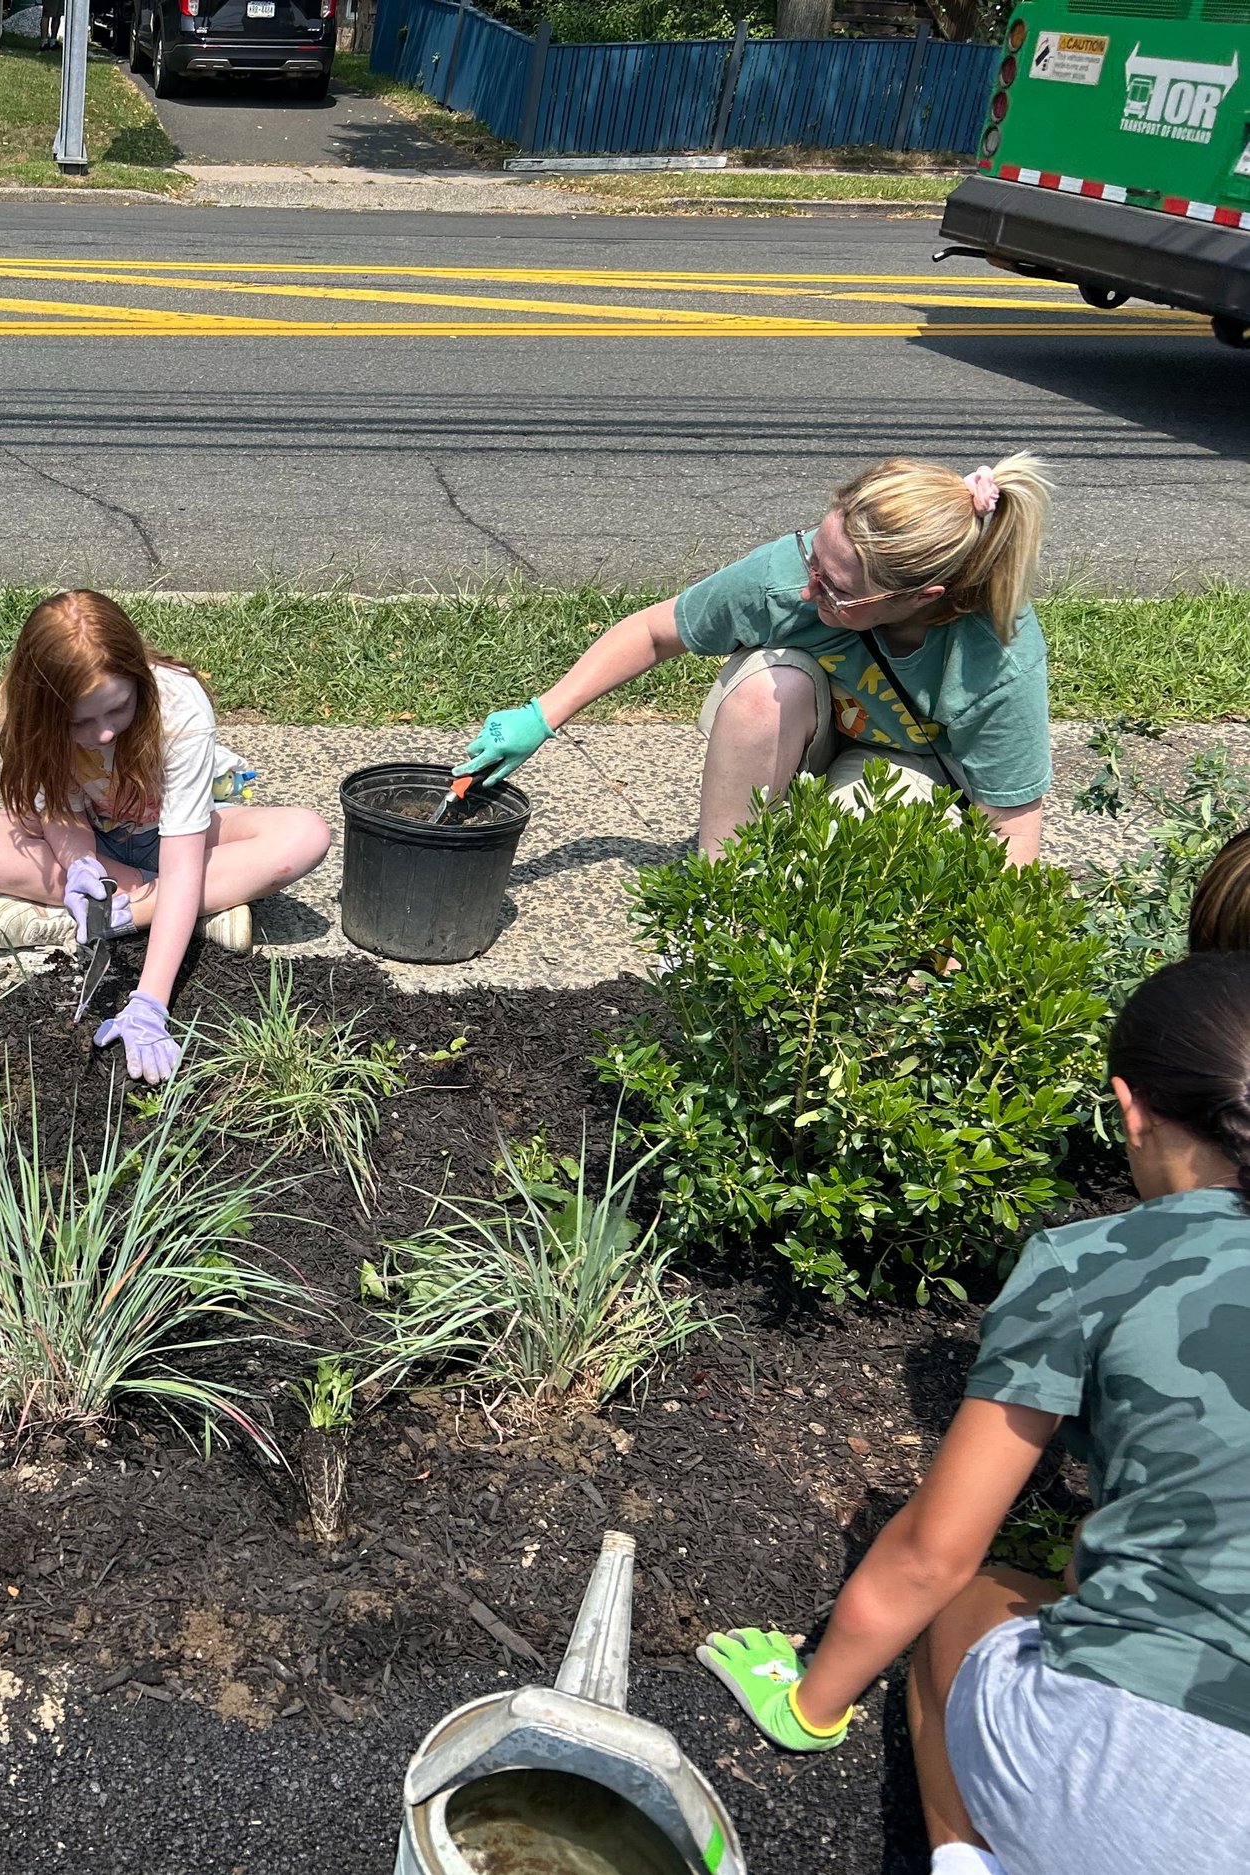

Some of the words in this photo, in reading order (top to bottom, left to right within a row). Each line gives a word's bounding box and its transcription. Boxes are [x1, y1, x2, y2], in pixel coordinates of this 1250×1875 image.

[1066, 38, 1104, 51] CAUTION
[1125, 42, 1239, 129] TOR
[1120, 119, 1161, 135] TRANSPORT
[1161, 125, 1172, 137] OF
[1171, 127, 1212, 144] ROCKLAND
